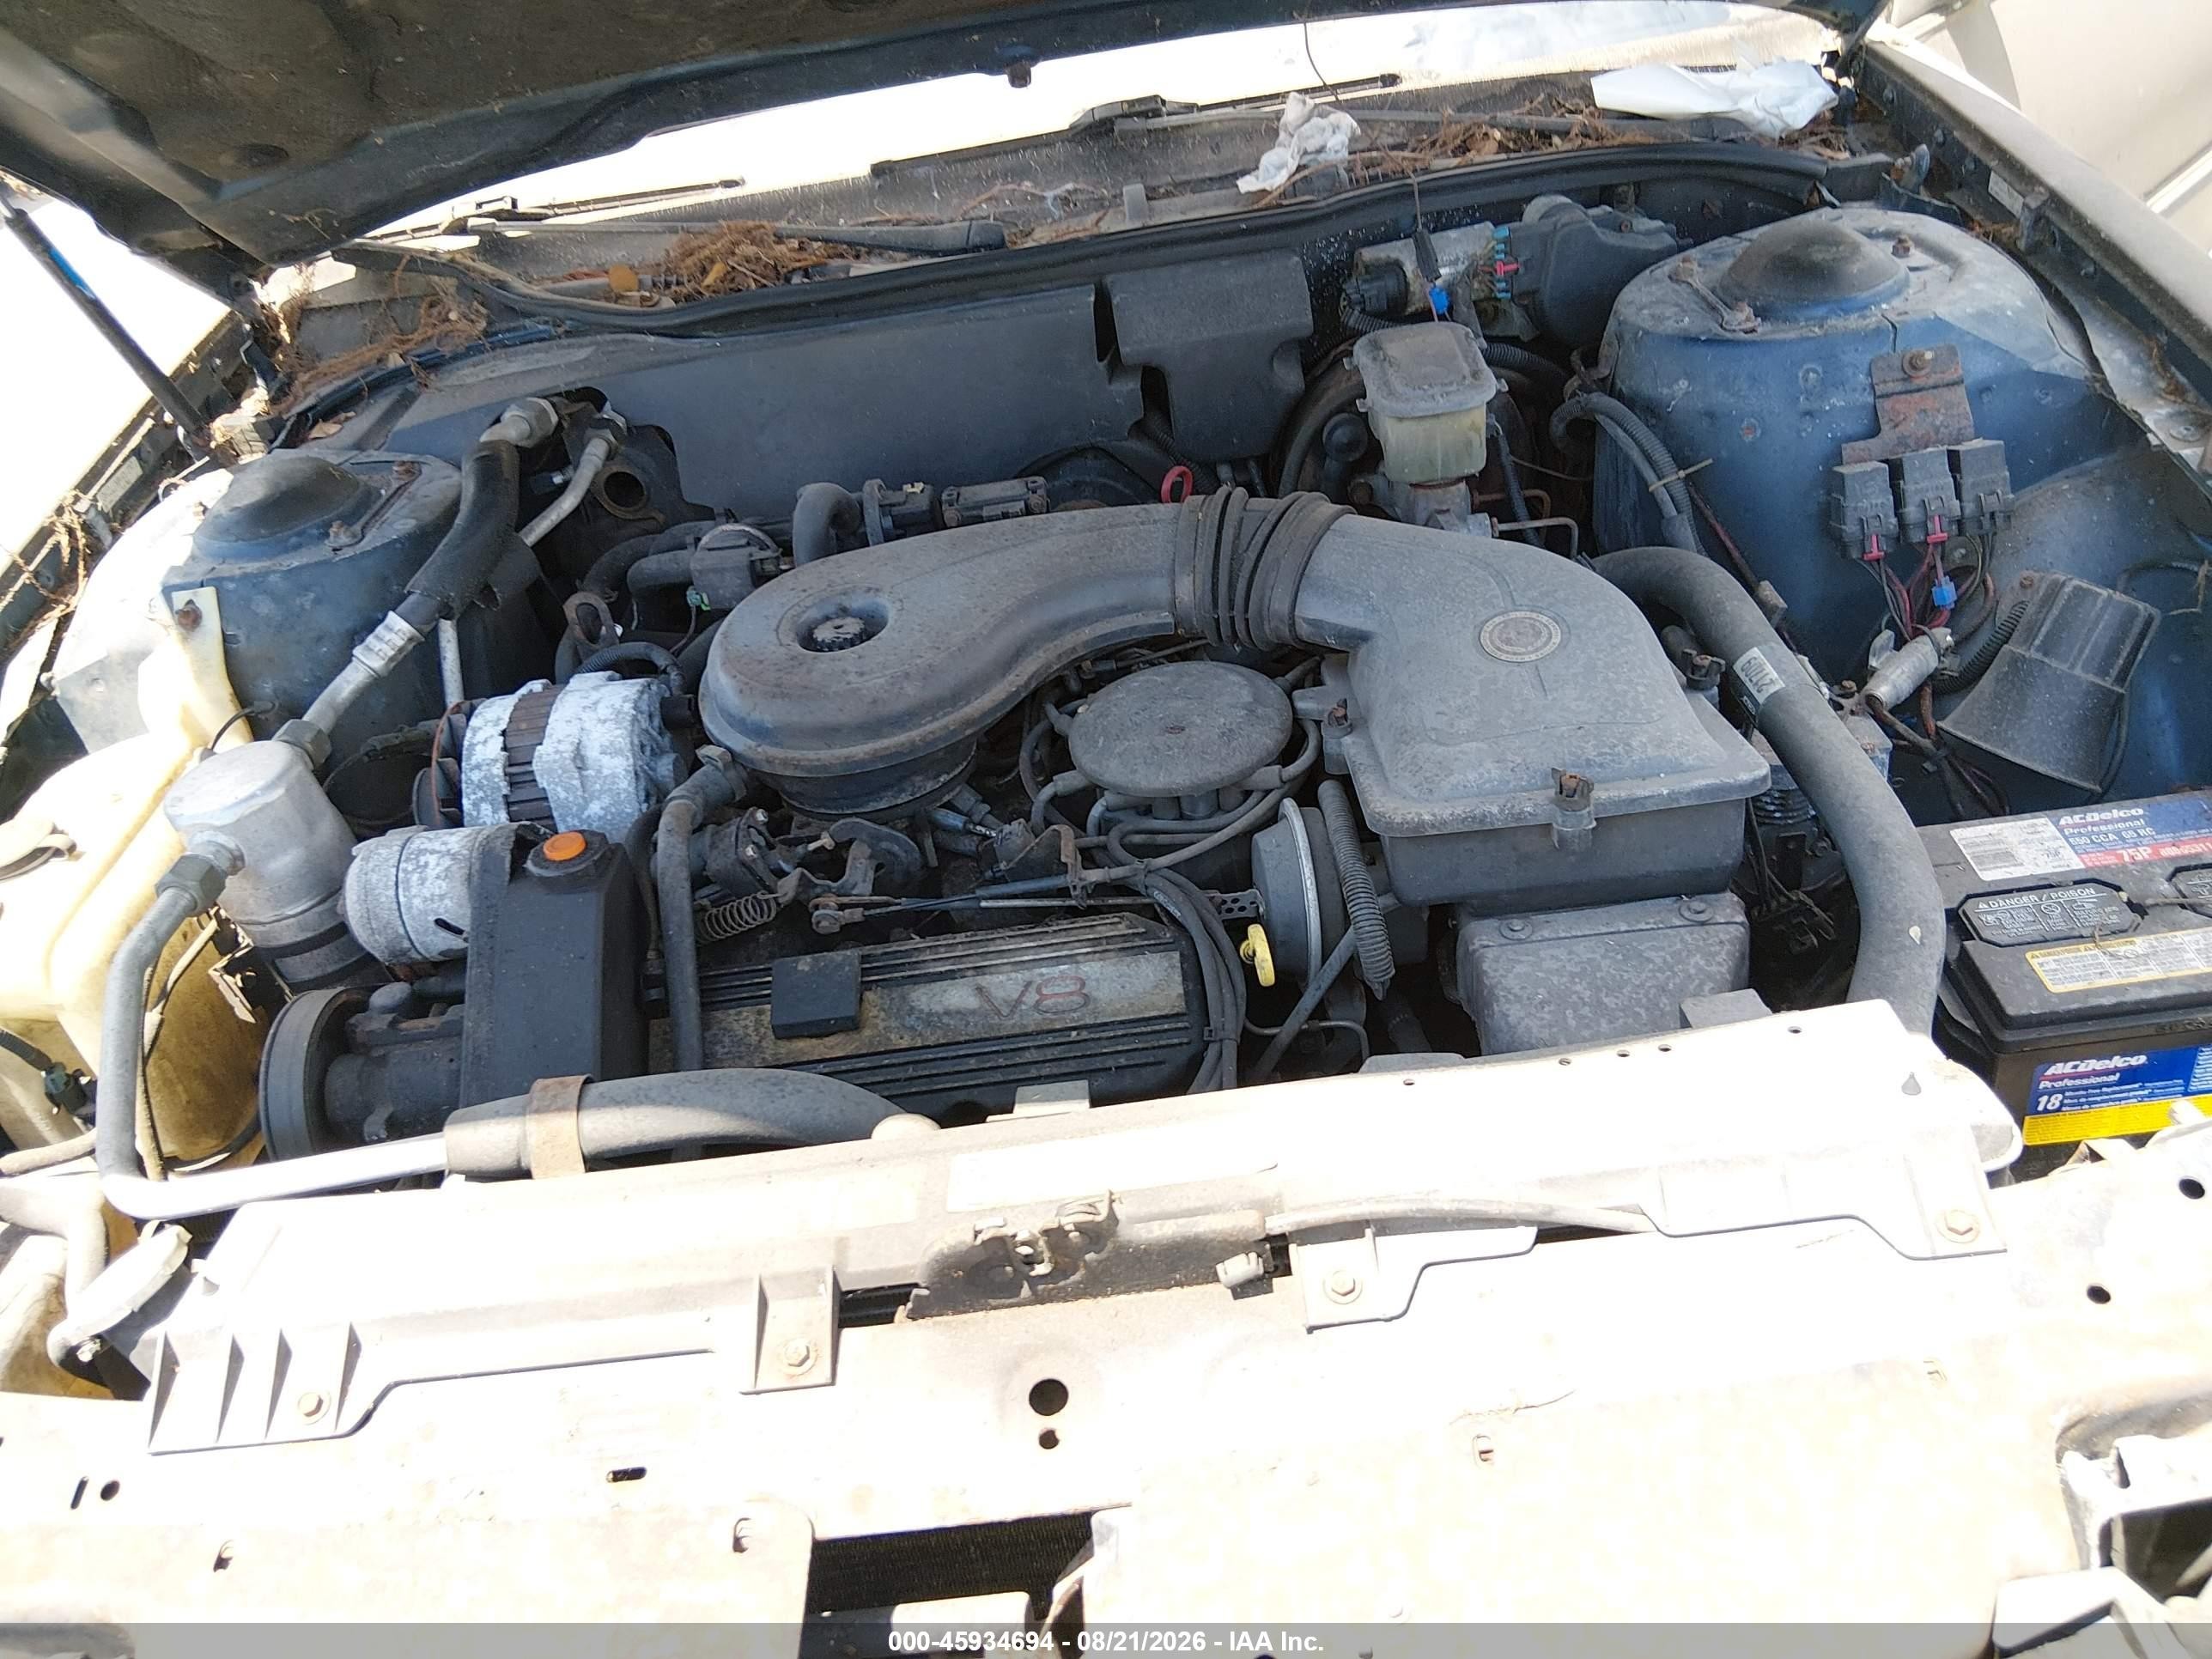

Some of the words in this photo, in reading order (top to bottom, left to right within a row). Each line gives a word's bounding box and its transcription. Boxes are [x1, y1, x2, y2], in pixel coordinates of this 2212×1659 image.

[2059, 807, 2144, 825] ACDelco
[2063, 818, 2146, 836] Professional
[2092, 832, 2118, 842] CCA
[2136, 827, 2156, 837] RC
[2116, 846, 2153, 863] 75P
[1988, 894, 2039, 908] DANGER
[2049, 887, 2096, 900] POISON
[975, 974, 1090, 1020] V8
[2043, 1054, 2147, 1076] ACDelco
[2039, 1073, 2121, 1090] Professional
[2037, 1093, 2063, 1111] 18
